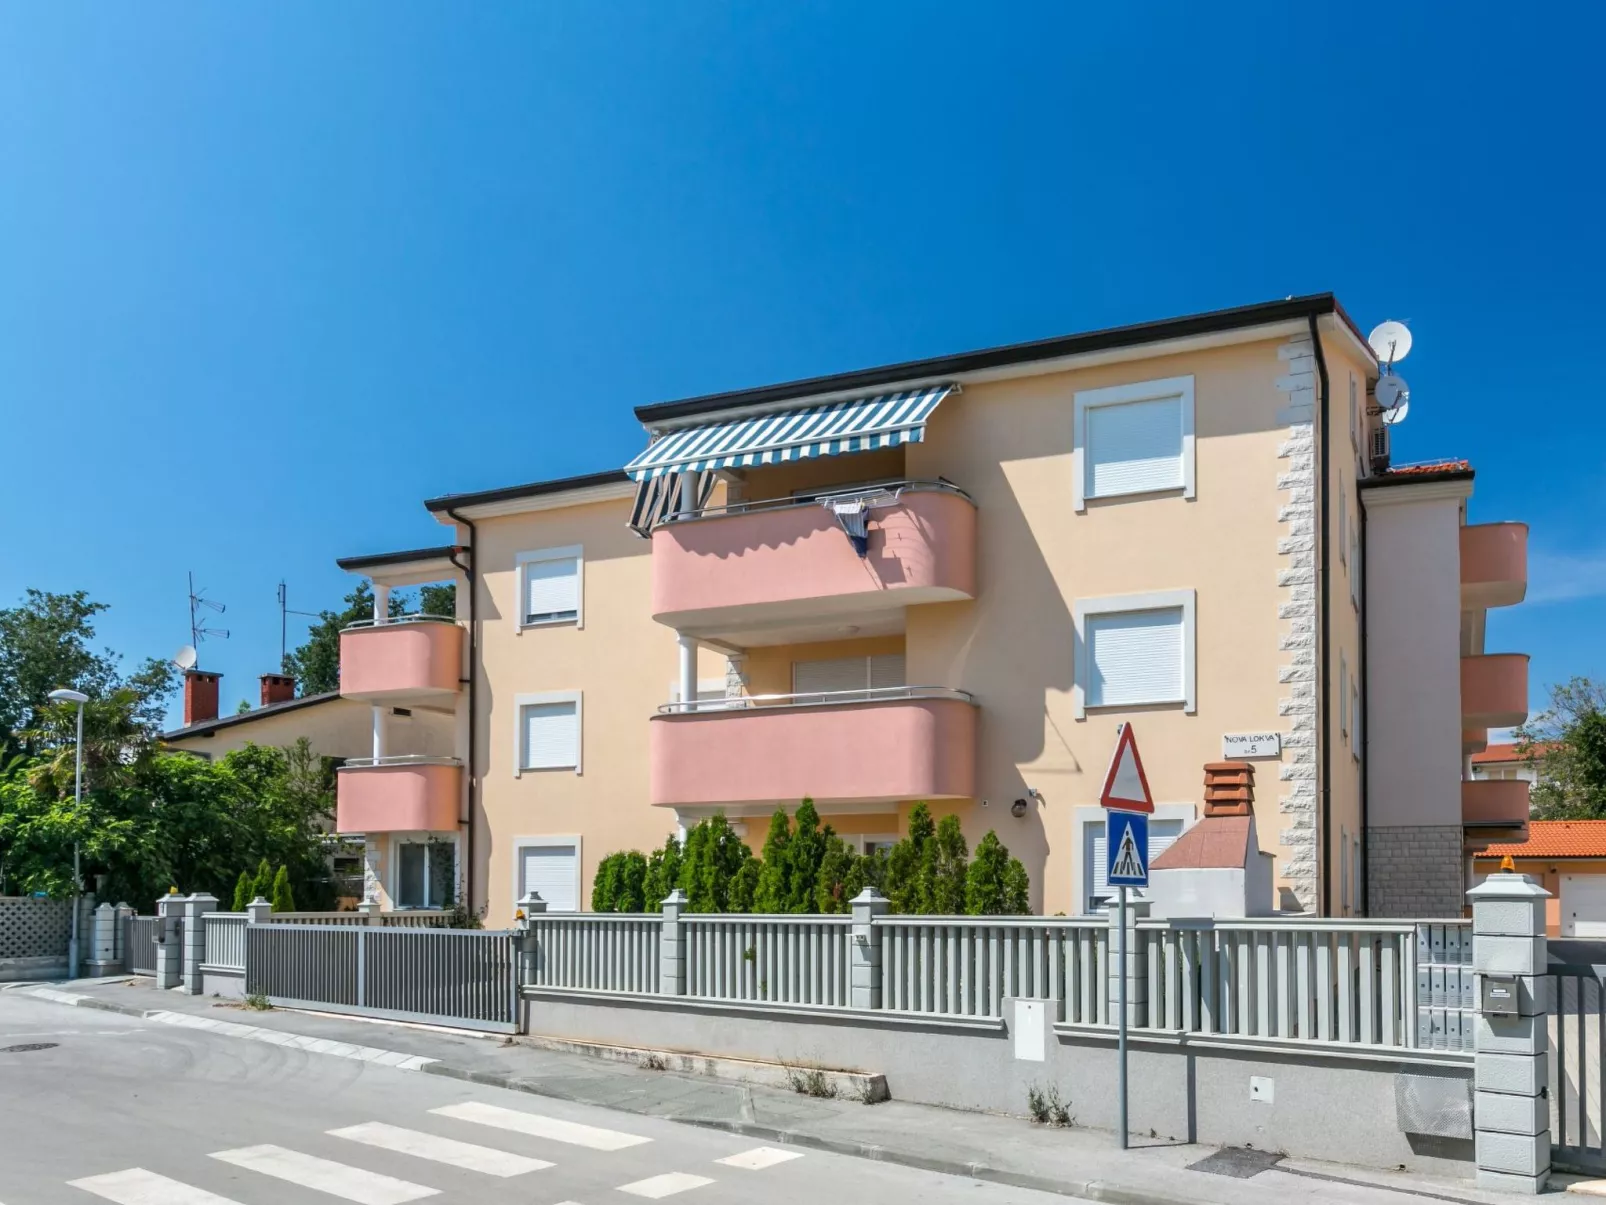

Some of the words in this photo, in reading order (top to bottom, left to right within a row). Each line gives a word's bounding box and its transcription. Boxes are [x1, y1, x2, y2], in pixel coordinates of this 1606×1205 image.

[1226, 736, 1247, 744] NOVA
[1250, 734, 1275, 743] LOKVA
[1251, 745, 1257, 754] 5
